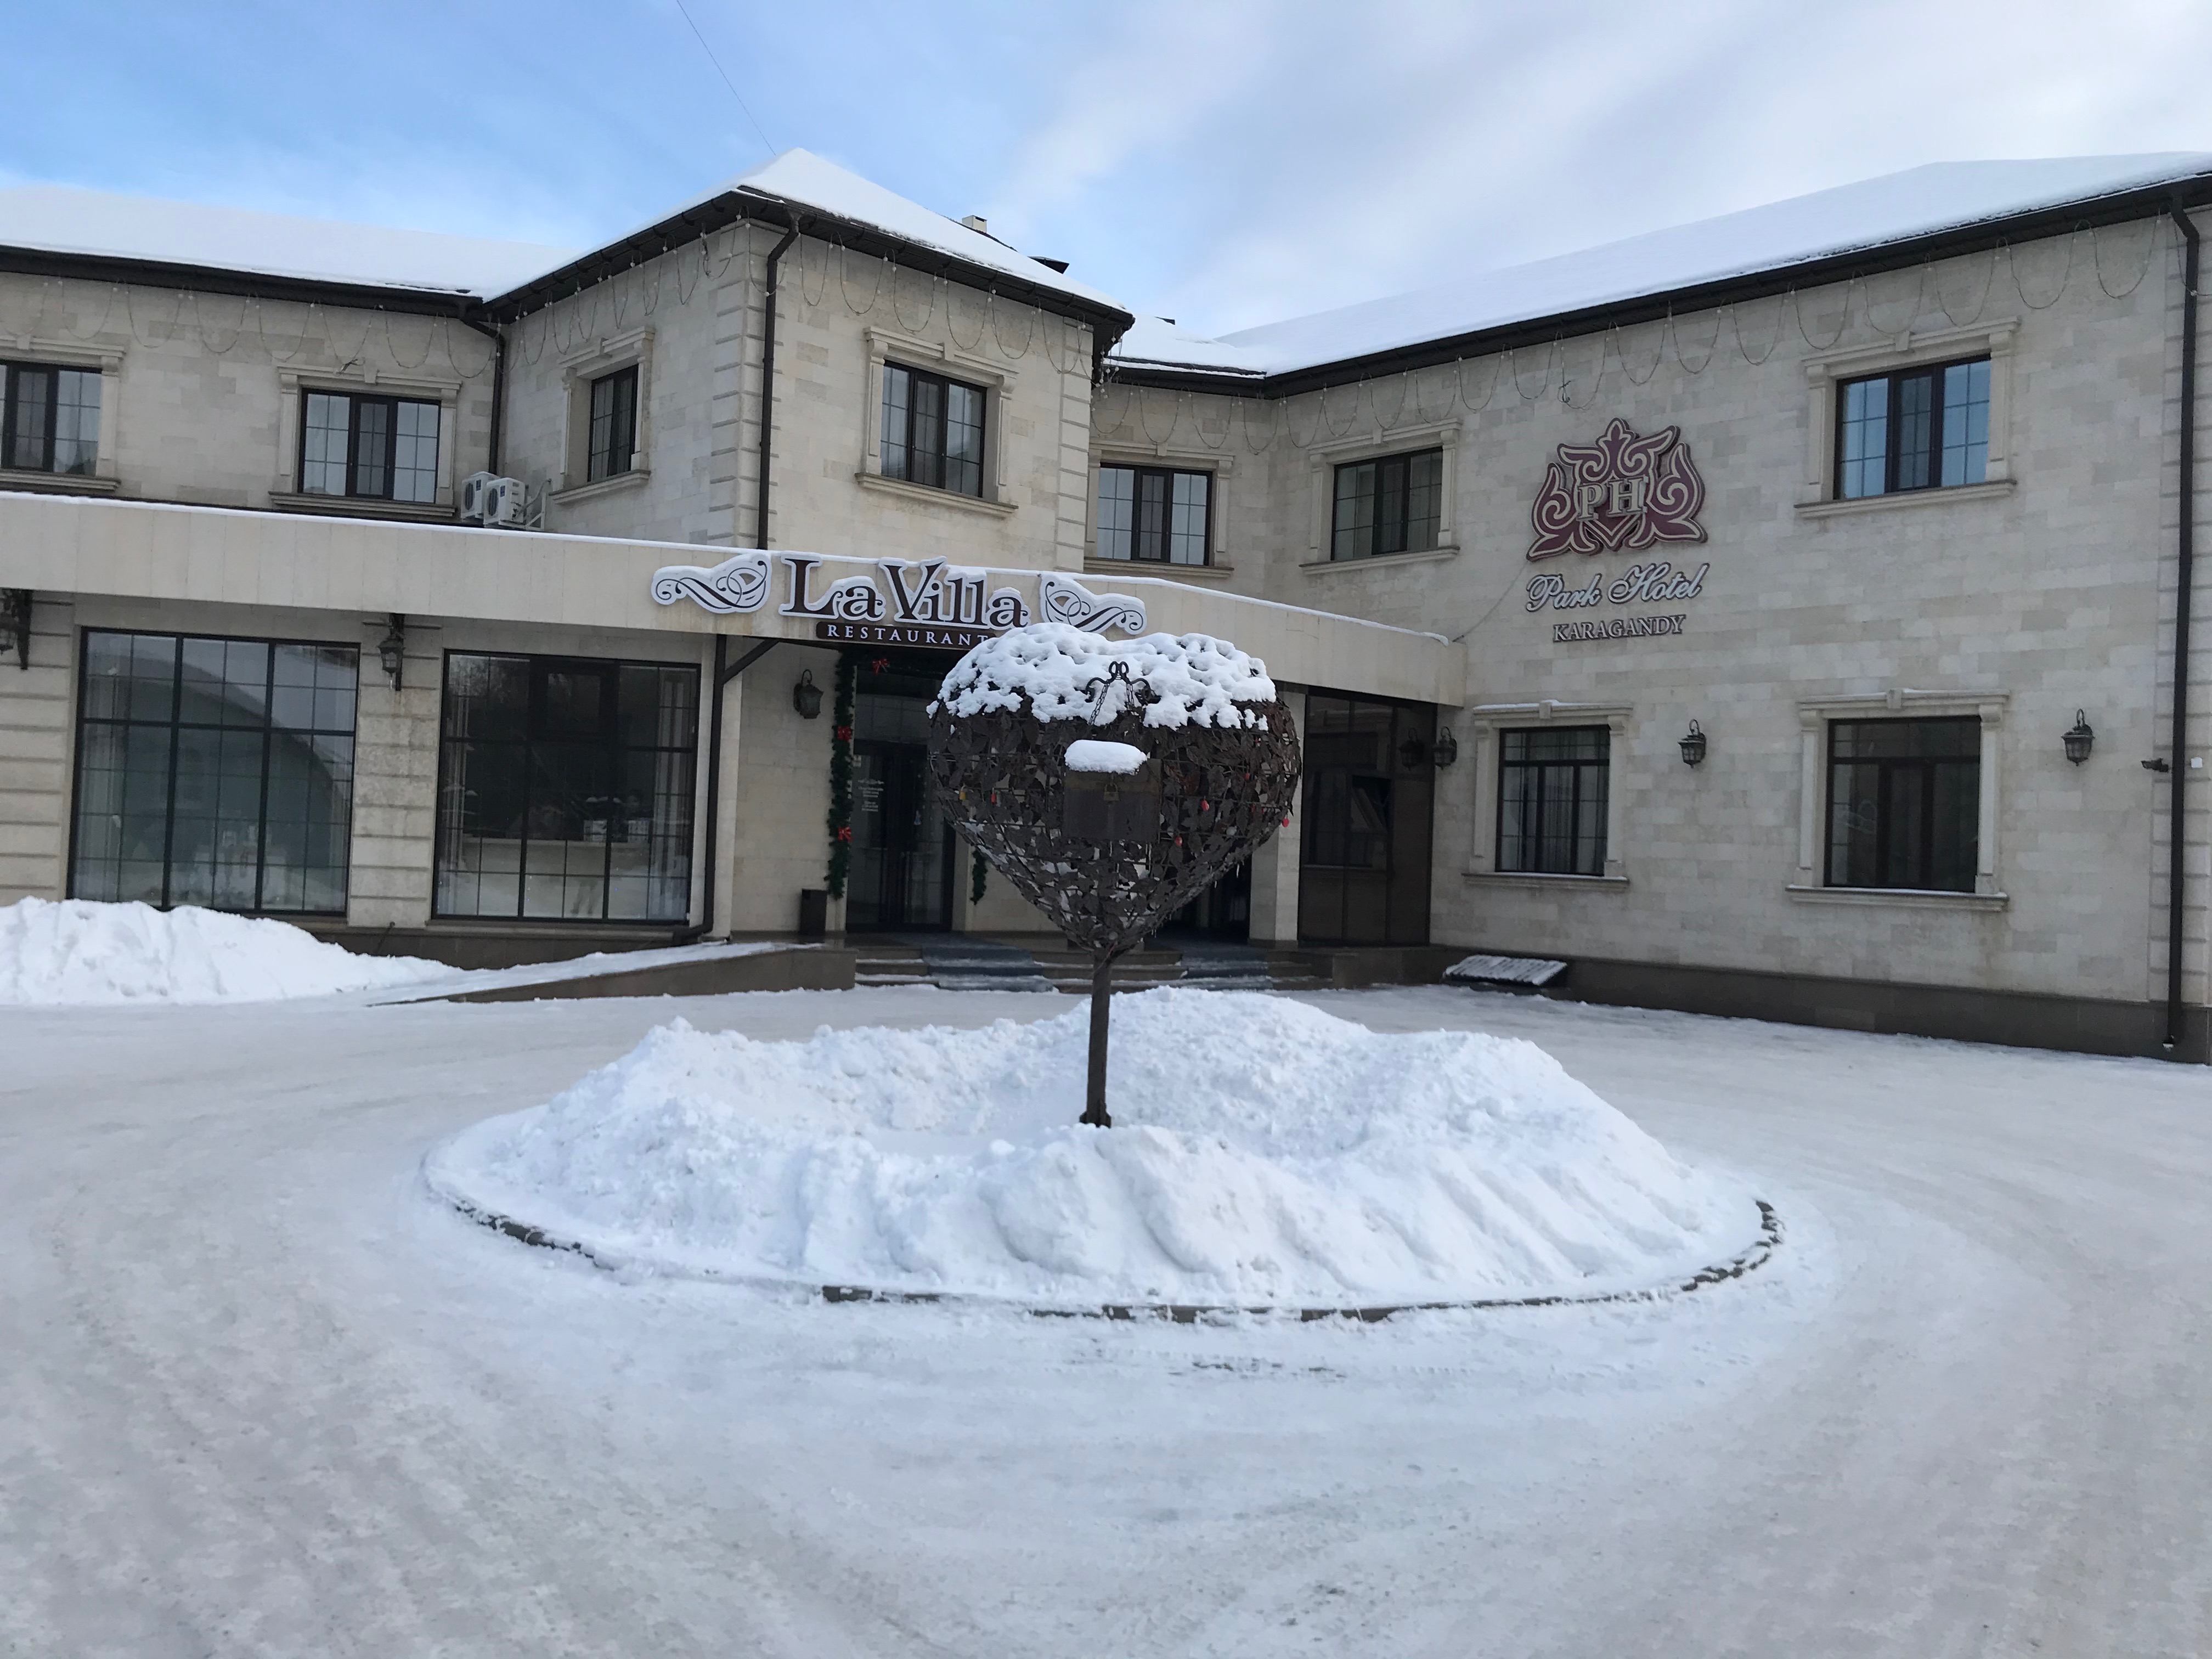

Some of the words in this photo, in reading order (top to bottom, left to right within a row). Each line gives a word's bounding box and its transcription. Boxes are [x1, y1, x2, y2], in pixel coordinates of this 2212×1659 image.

[782, 556, 884, 620] La
[881, 560, 1030, 628] Villa
[1526, 574, 1602, 612] Park
[1607, 562, 1709, 603] Hotel
[1553, 614, 1686, 642] KARAGANDY
